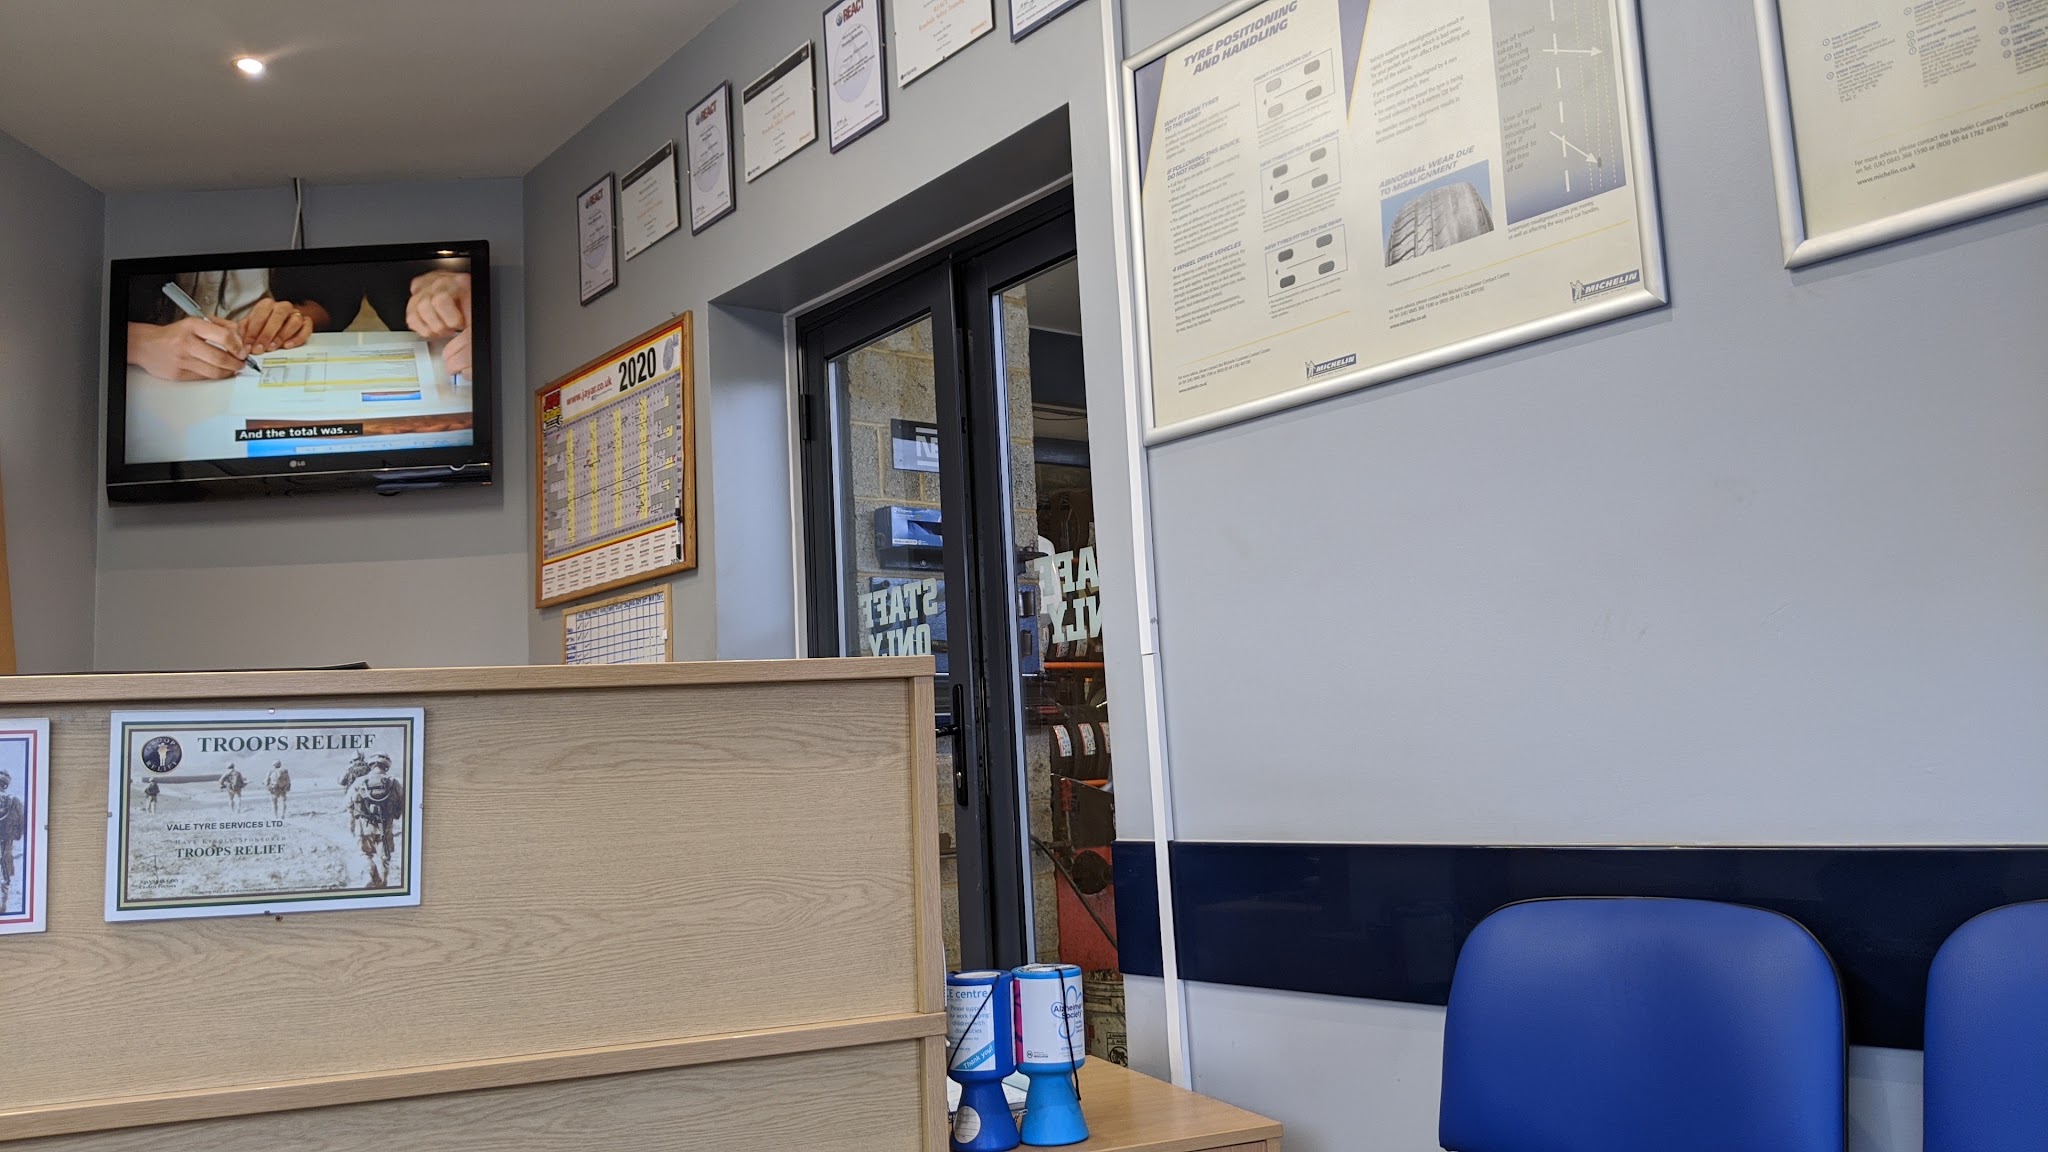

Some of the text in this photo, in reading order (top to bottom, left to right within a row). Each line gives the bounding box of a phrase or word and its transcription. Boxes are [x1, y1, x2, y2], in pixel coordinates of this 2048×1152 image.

[842, 0, 864, 22] REACT
[1183, 0, 1298, 67] TYRE POSITIONING
[1193, 18, 1288, 76] AND HANDLING
[1864, 155, 1878, 164] more
[1899, 142, 1916, 154] please
[1917, 135, 1938, 147] contact
[1950, 124, 1975, 136] Michelin
[1976, 114, 2004, 128] Customer
[2004, 106, 2029, 118] Contact
[1873, 161, 1886, 170] (UK)
[1886, 155, 1900, 165] 0845
[1901, 151, 1912, 160] 366
[1913, 146, 1928, 155] 1590
[1970, 128, 1985, 138] 1782
[1985, 120, 2009, 133] 401590
[1379, 145, 1475, 188] ABNORMAL WEAR DUE
[1857, 163, 1916, 186] www.michelin.co.uk
[1380, 160, 1458, 197] TO MISALIGNMENT
[1507, 222, 1530, 233] Suspension
[1530, 212, 1558, 226] misalignment
[1559, 208, 1570, 216] costs
[1529, 223, 1547, 234] affecting
[1215, 241, 1241, 256] VEHICLES
[1585, 272, 1638, 293] MICHELIN
[619, 347, 657, 392] 2020
[1316, 356, 1355, 373] MICHELIN
[566, 376, 613, 406] www.jayar.co.uk
[239, 427, 358, 440] And the total was...
[197, 734, 376, 753] TROOPS RELIEF
[167, 823, 191, 831] VALE
[220, 821, 263, 829] SERVICES
[175, 844, 285, 858] TROOPS RELIEF
[956, 990, 988, 998] centre
[963, 1045, 993, 1069] Thank you!
